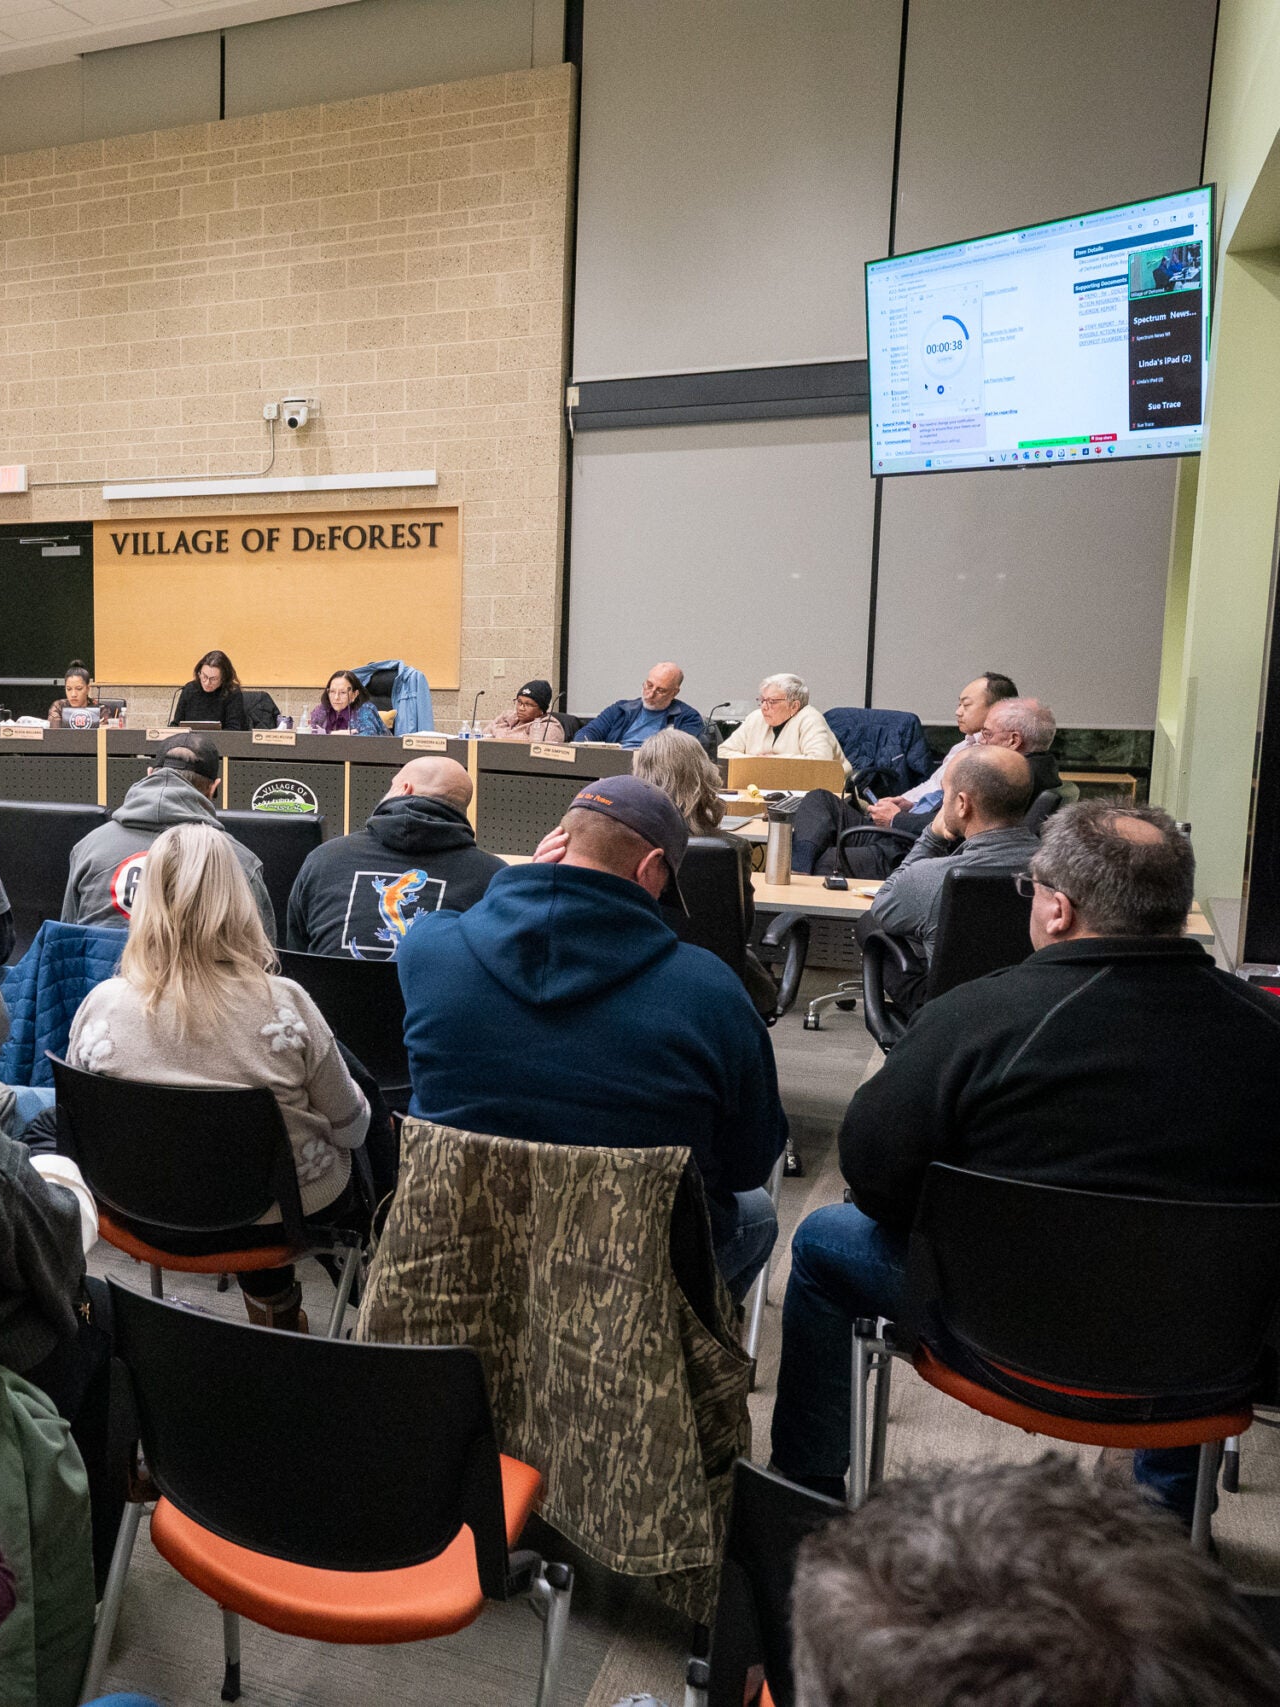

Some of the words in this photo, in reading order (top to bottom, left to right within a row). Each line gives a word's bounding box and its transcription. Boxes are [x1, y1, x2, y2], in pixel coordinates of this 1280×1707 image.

[1133, 313, 1167, 326] Spectrum
[926, 340, 963, 355] 00:00:38
[1138, 358, 1163, 368] Linda's
[1181, 354, 1192, 363] (2)
[1148, 402, 1161, 411] Sue
[1162, 401, 1181, 409] Trace
[110, 529, 229, 555] VILLAGE
[241, 527, 280, 553] OF
[261, 783, 295, 795] VILLAGE
[297, 786, 308, 797] OF
